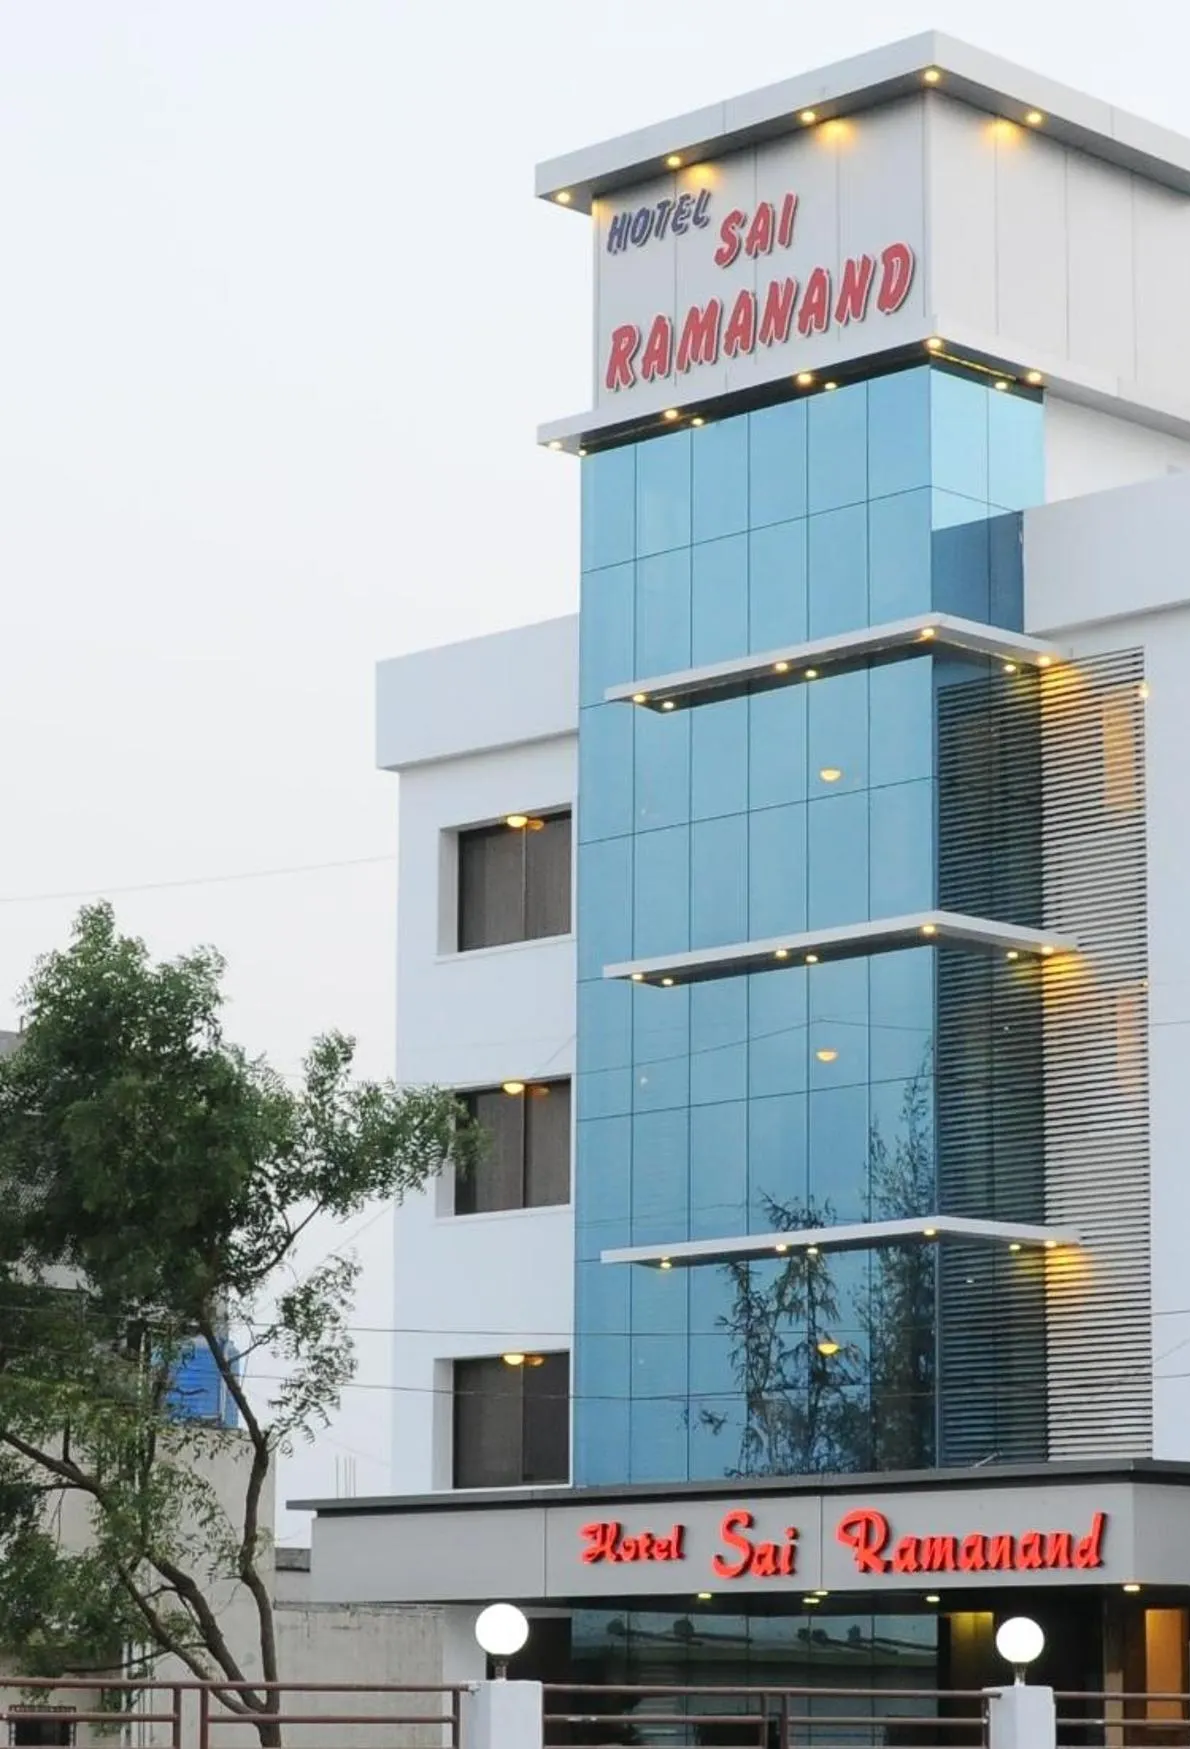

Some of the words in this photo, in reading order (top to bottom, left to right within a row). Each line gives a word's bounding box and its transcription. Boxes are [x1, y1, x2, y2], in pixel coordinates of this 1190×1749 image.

[607, 189, 711, 253] HOTEL
[714, 193, 798, 268] SAI
[605, 242, 916, 392] RAMANAND
[580, 1522, 685, 1564] Hotel
[712, 1510, 799, 1578] Sai
[837, 1509, 1108, 1575] Ramanand
